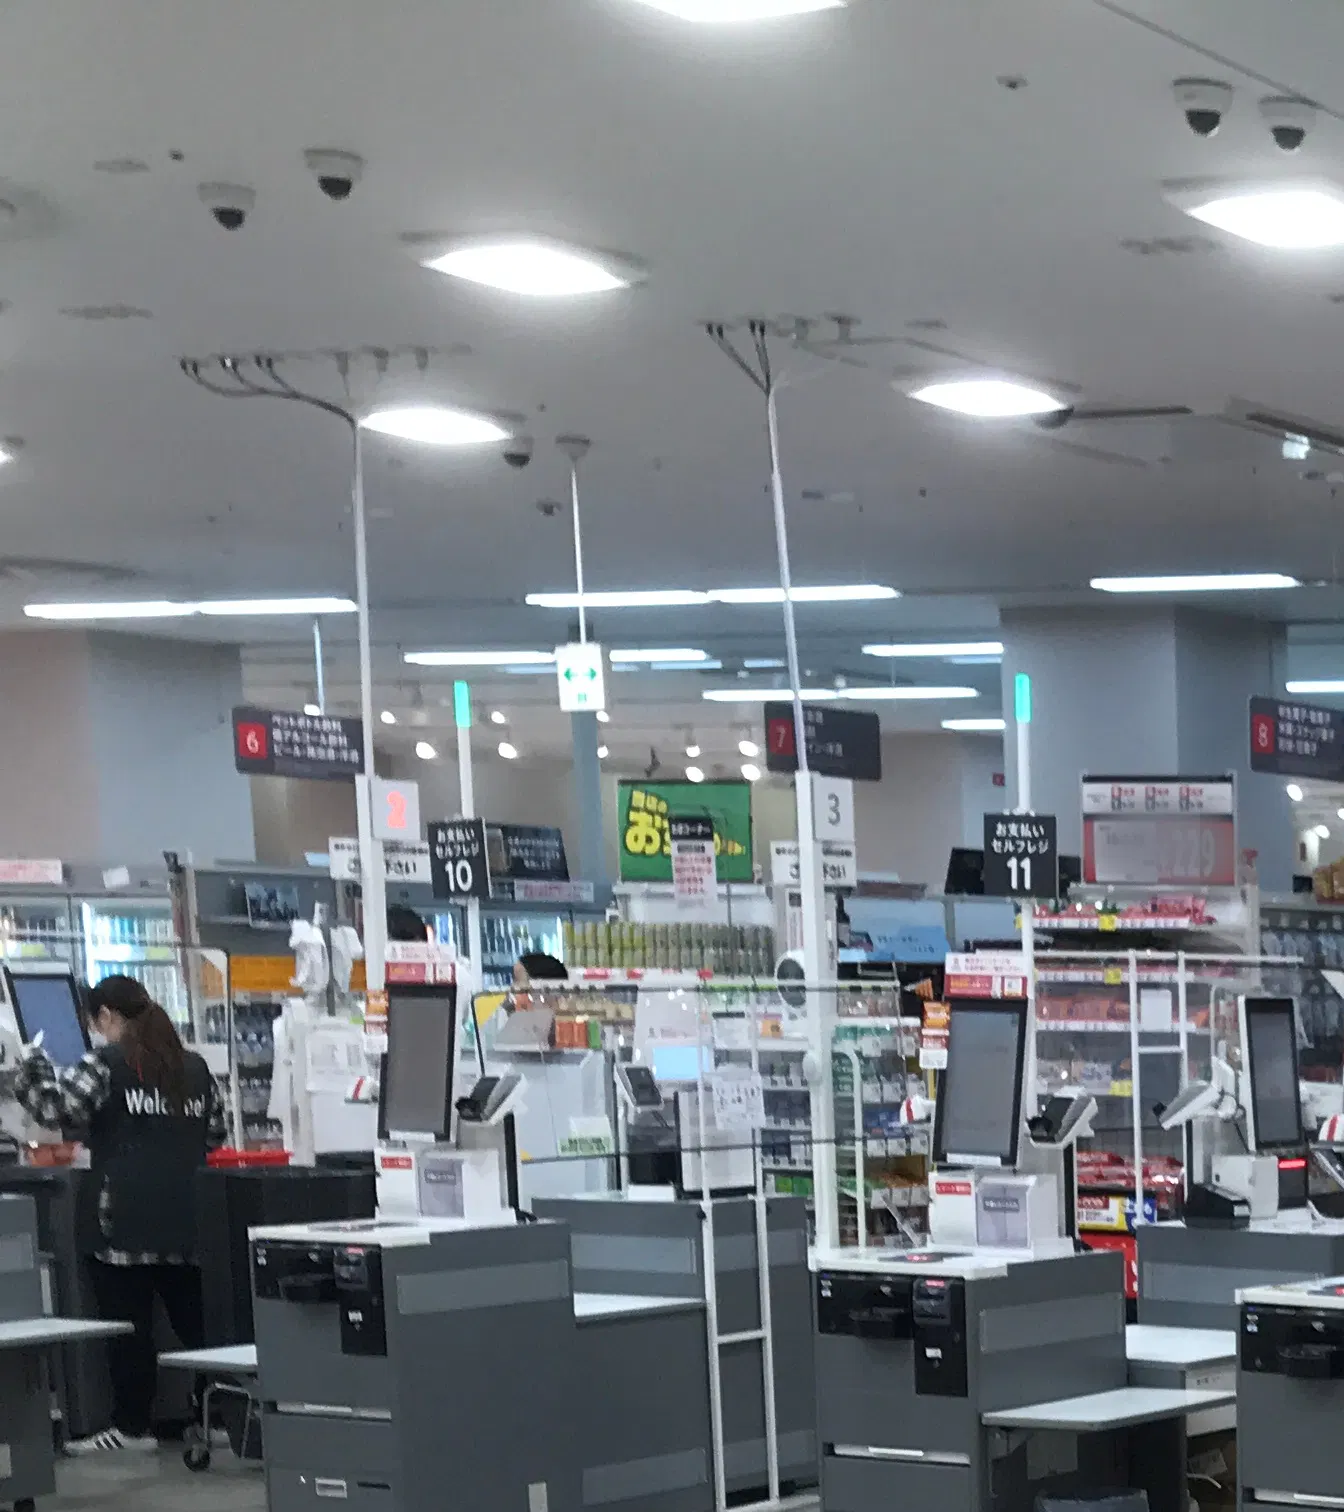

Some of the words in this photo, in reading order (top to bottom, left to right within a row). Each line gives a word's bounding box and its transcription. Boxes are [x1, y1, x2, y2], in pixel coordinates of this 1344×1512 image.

[246, 729, 259, 754] 6
[776, 725, 787, 748] 7
[1258, 722, 1268, 747] 8
[387, 790, 407, 828] 2
[827, 793, 841, 826] 3
[996, 823, 1045, 838] お支払い
[992, 839, 1049, 854] セルフレジ
[445, 860, 472, 892] 10
[1006, 857, 1032, 891] 11
